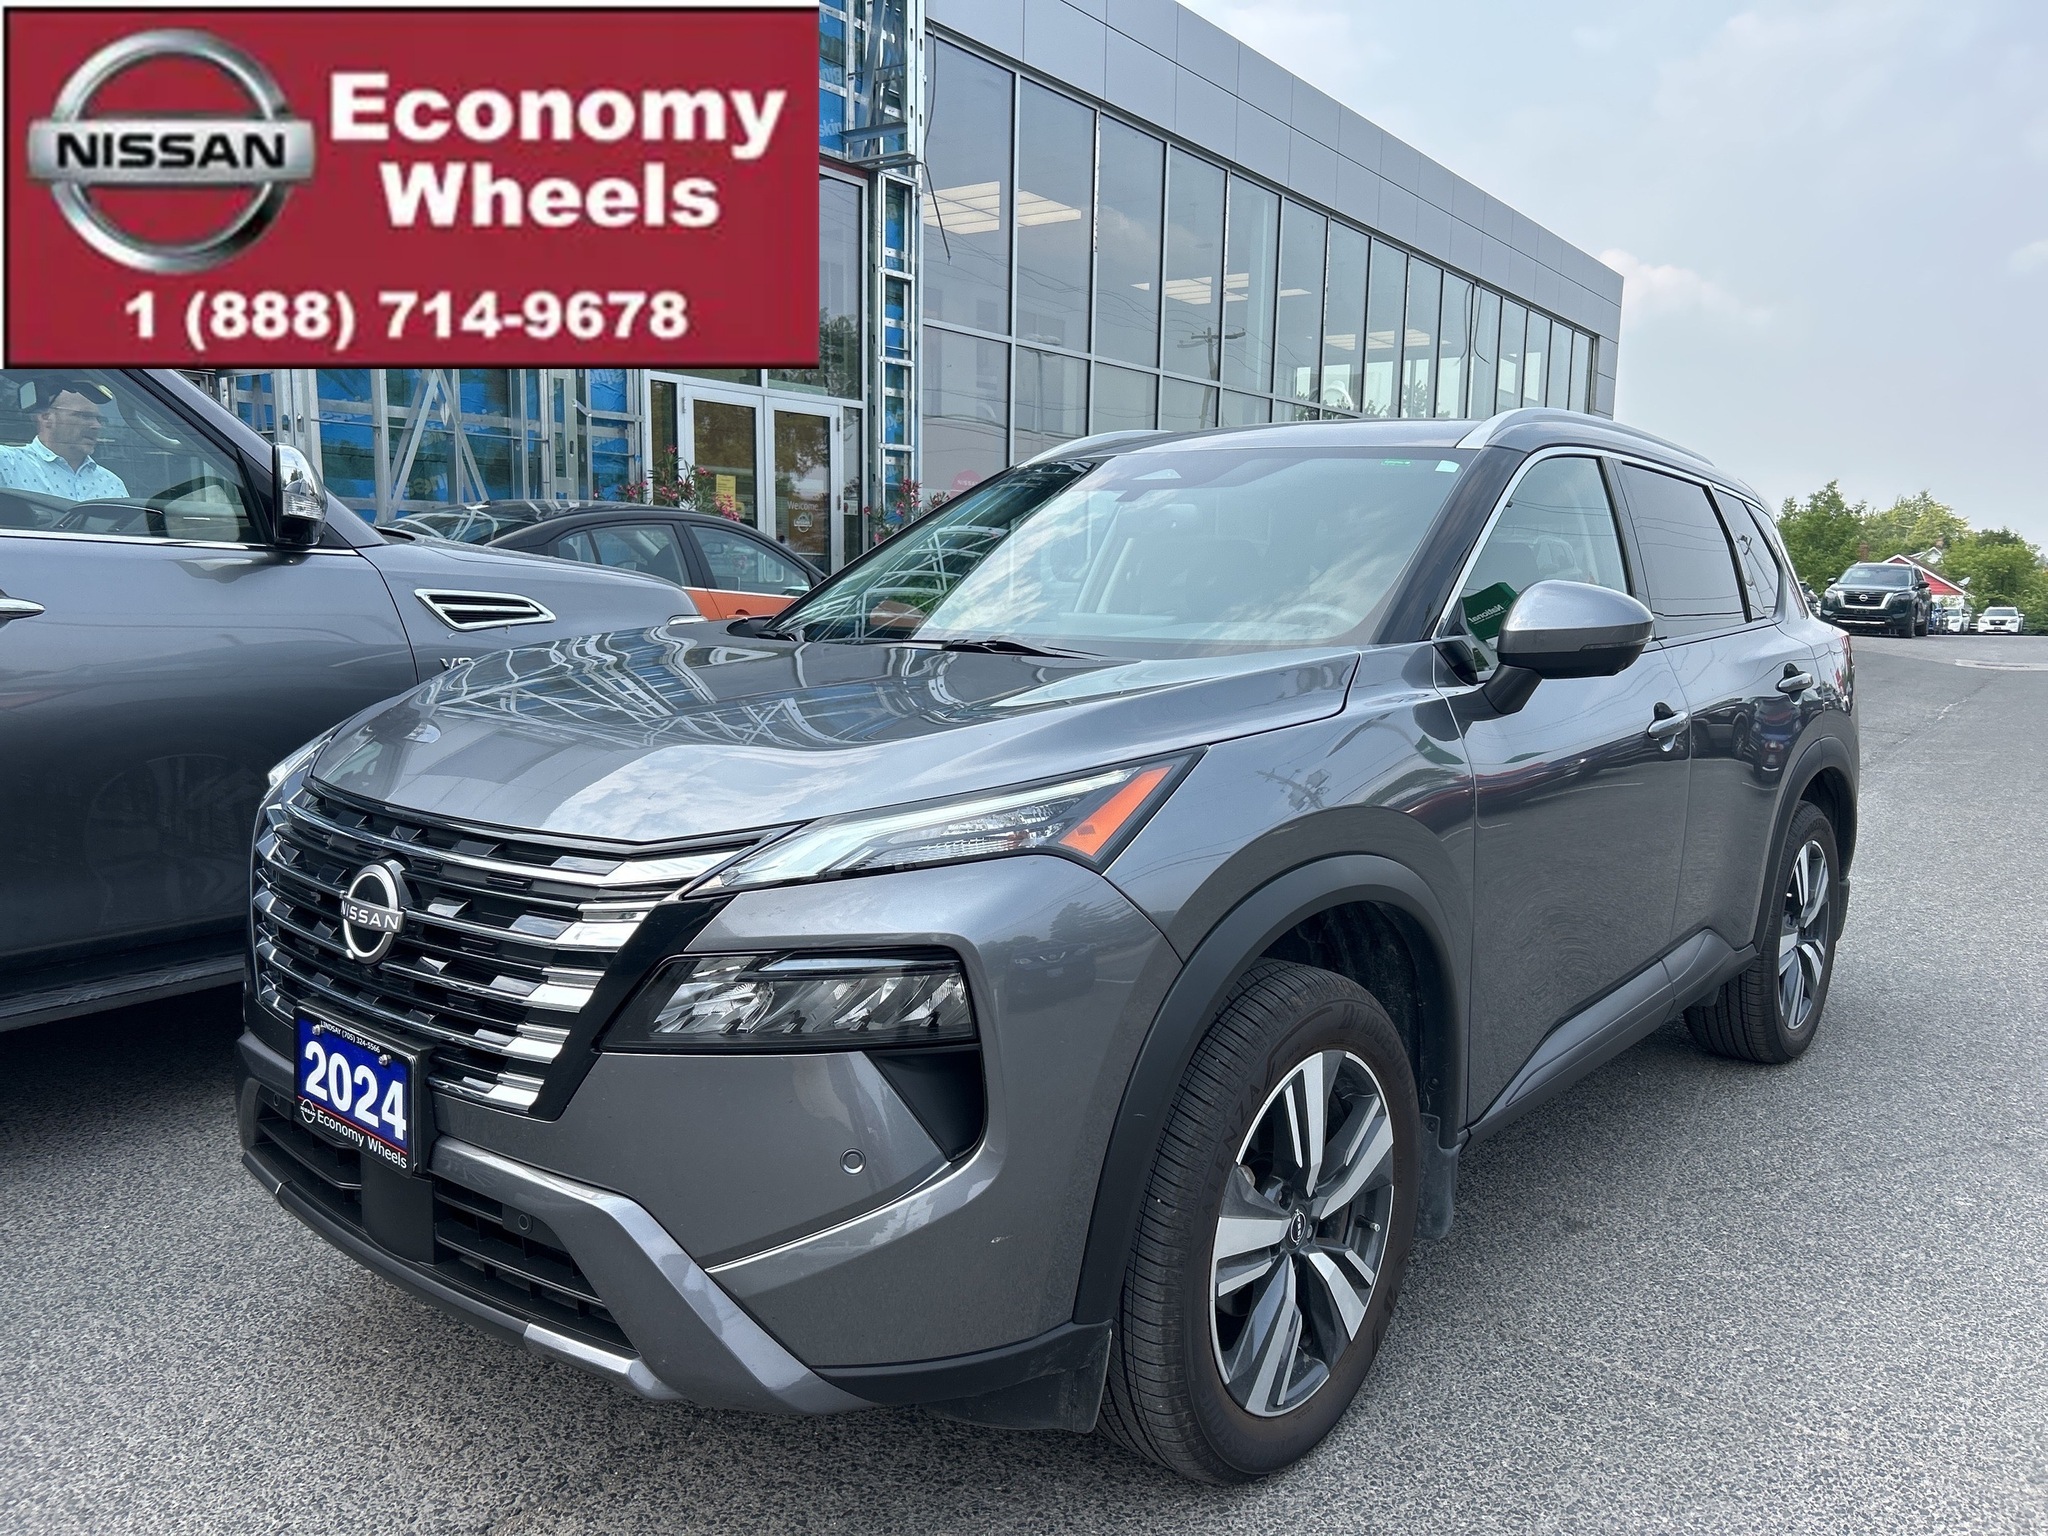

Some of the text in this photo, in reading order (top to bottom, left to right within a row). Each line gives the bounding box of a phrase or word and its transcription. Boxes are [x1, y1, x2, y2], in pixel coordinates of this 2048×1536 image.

[787, 501, 819, 511] Welcome
[341, 900, 399, 930] NISSAN
[320, 1020, 381, 1053] LINDSAY (705) 324-5566
[304, 1040, 407, 1141] 2024
[300, 1105, 316, 1117] NISSAN
[317, 1109, 407, 1169] Economy Wheels
